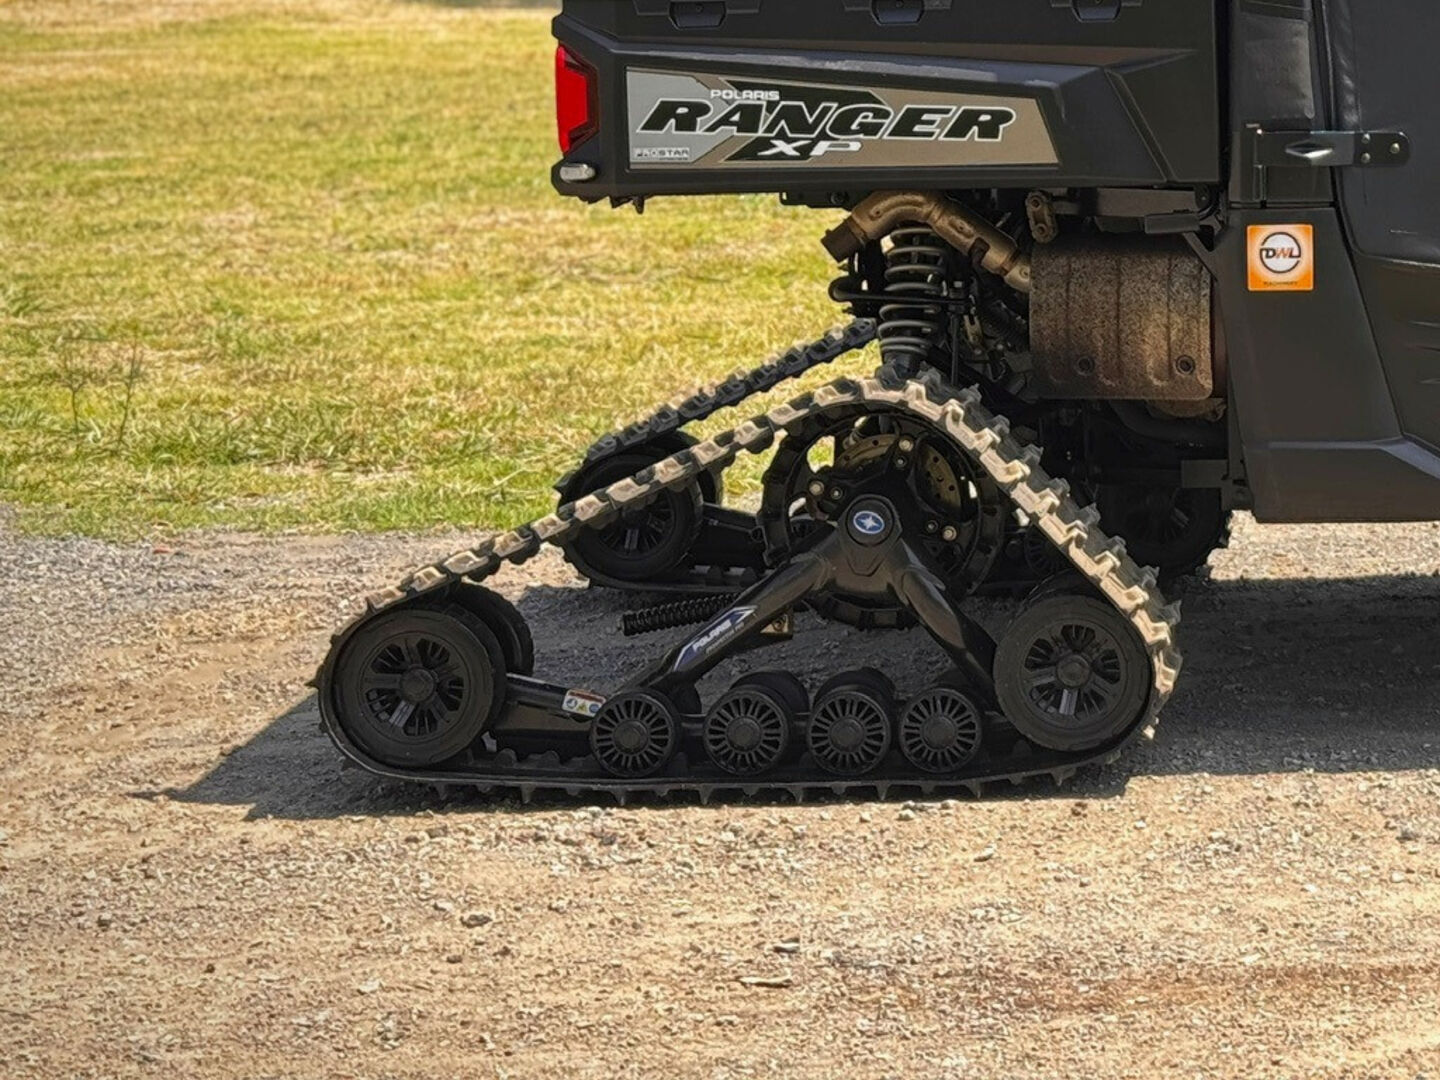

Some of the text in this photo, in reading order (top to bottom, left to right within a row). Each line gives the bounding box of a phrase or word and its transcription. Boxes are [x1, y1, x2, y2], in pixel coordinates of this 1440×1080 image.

[710, 89, 780, 100] POLARIS
[636, 98, 1016, 142] RANGER
[757, 139, 862, 156] XP
[692, 619, 732, 652] POLARIS
